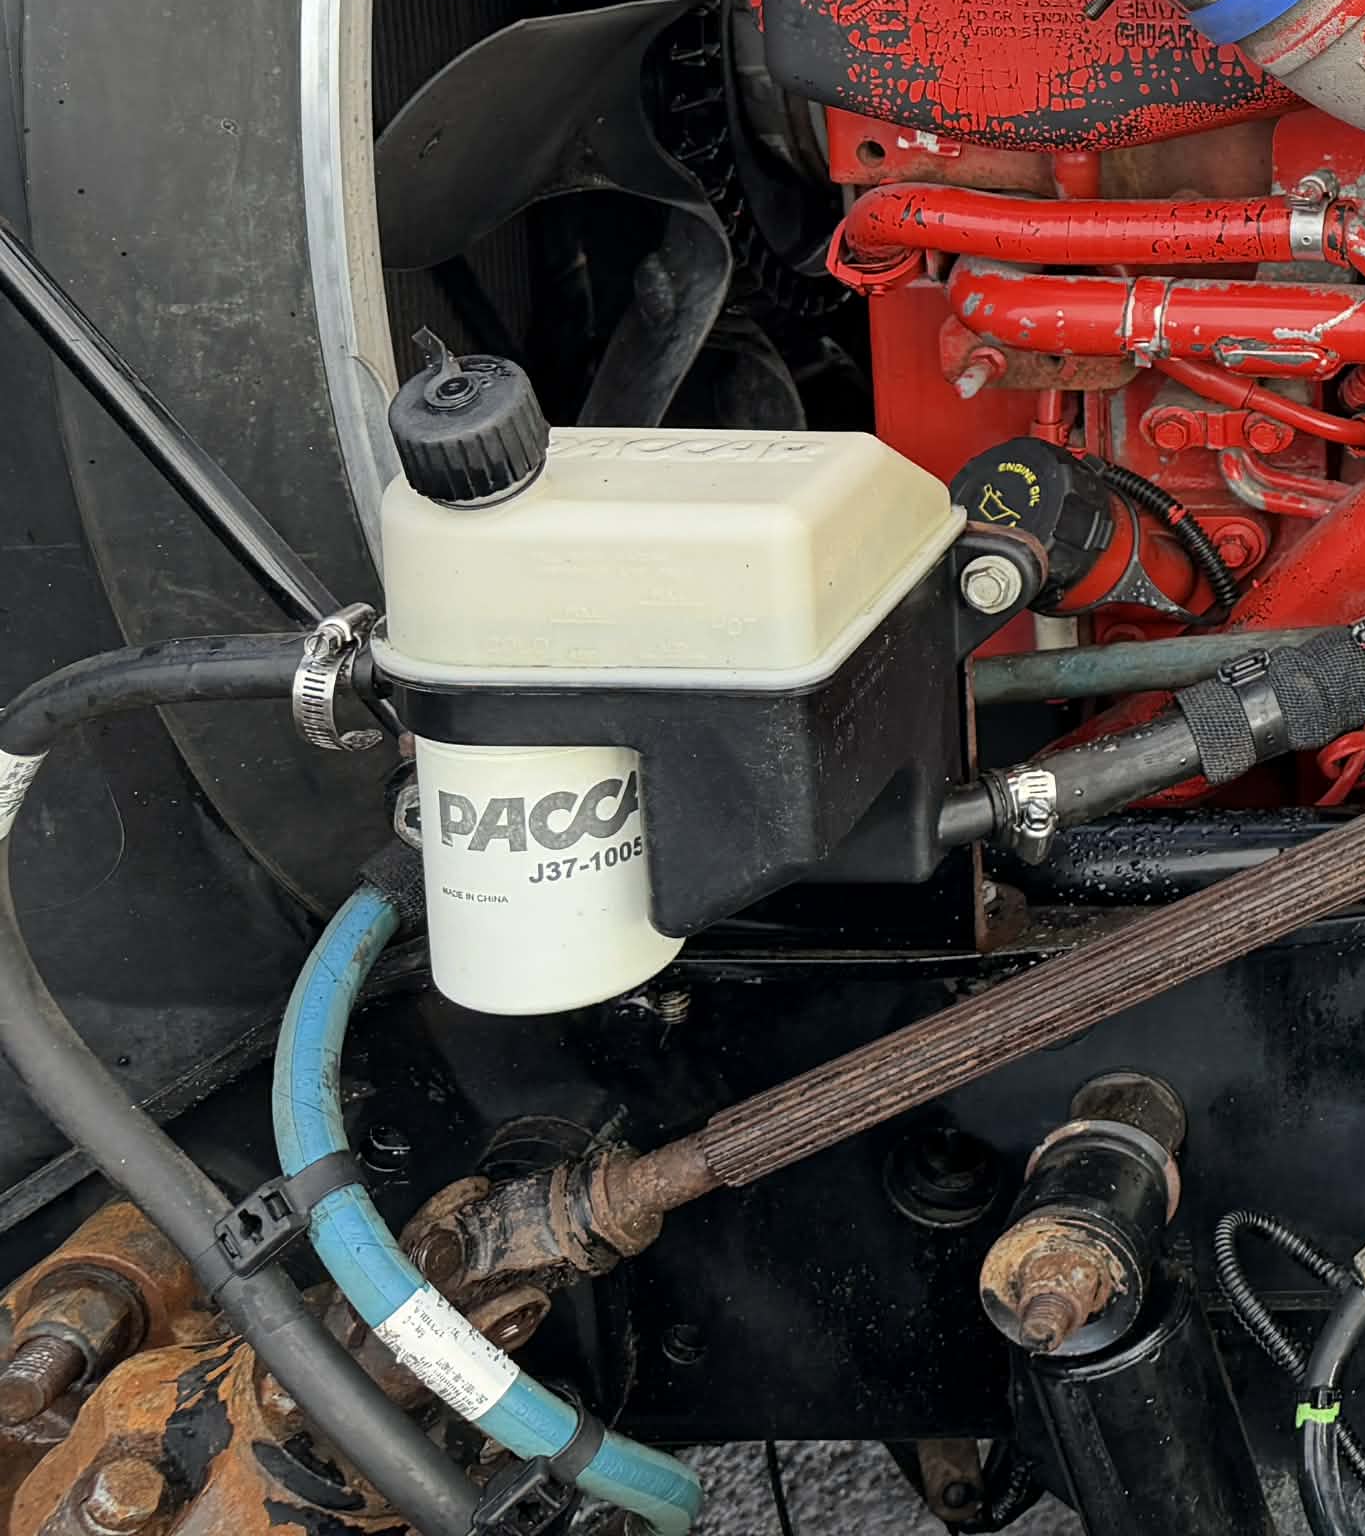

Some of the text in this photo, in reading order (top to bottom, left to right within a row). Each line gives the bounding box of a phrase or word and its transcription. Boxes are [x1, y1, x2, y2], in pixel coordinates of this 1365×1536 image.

[997, 462, 1041, 508] ENGINE OIL
[442, 887, 509, 904] MADE IN CHINA
